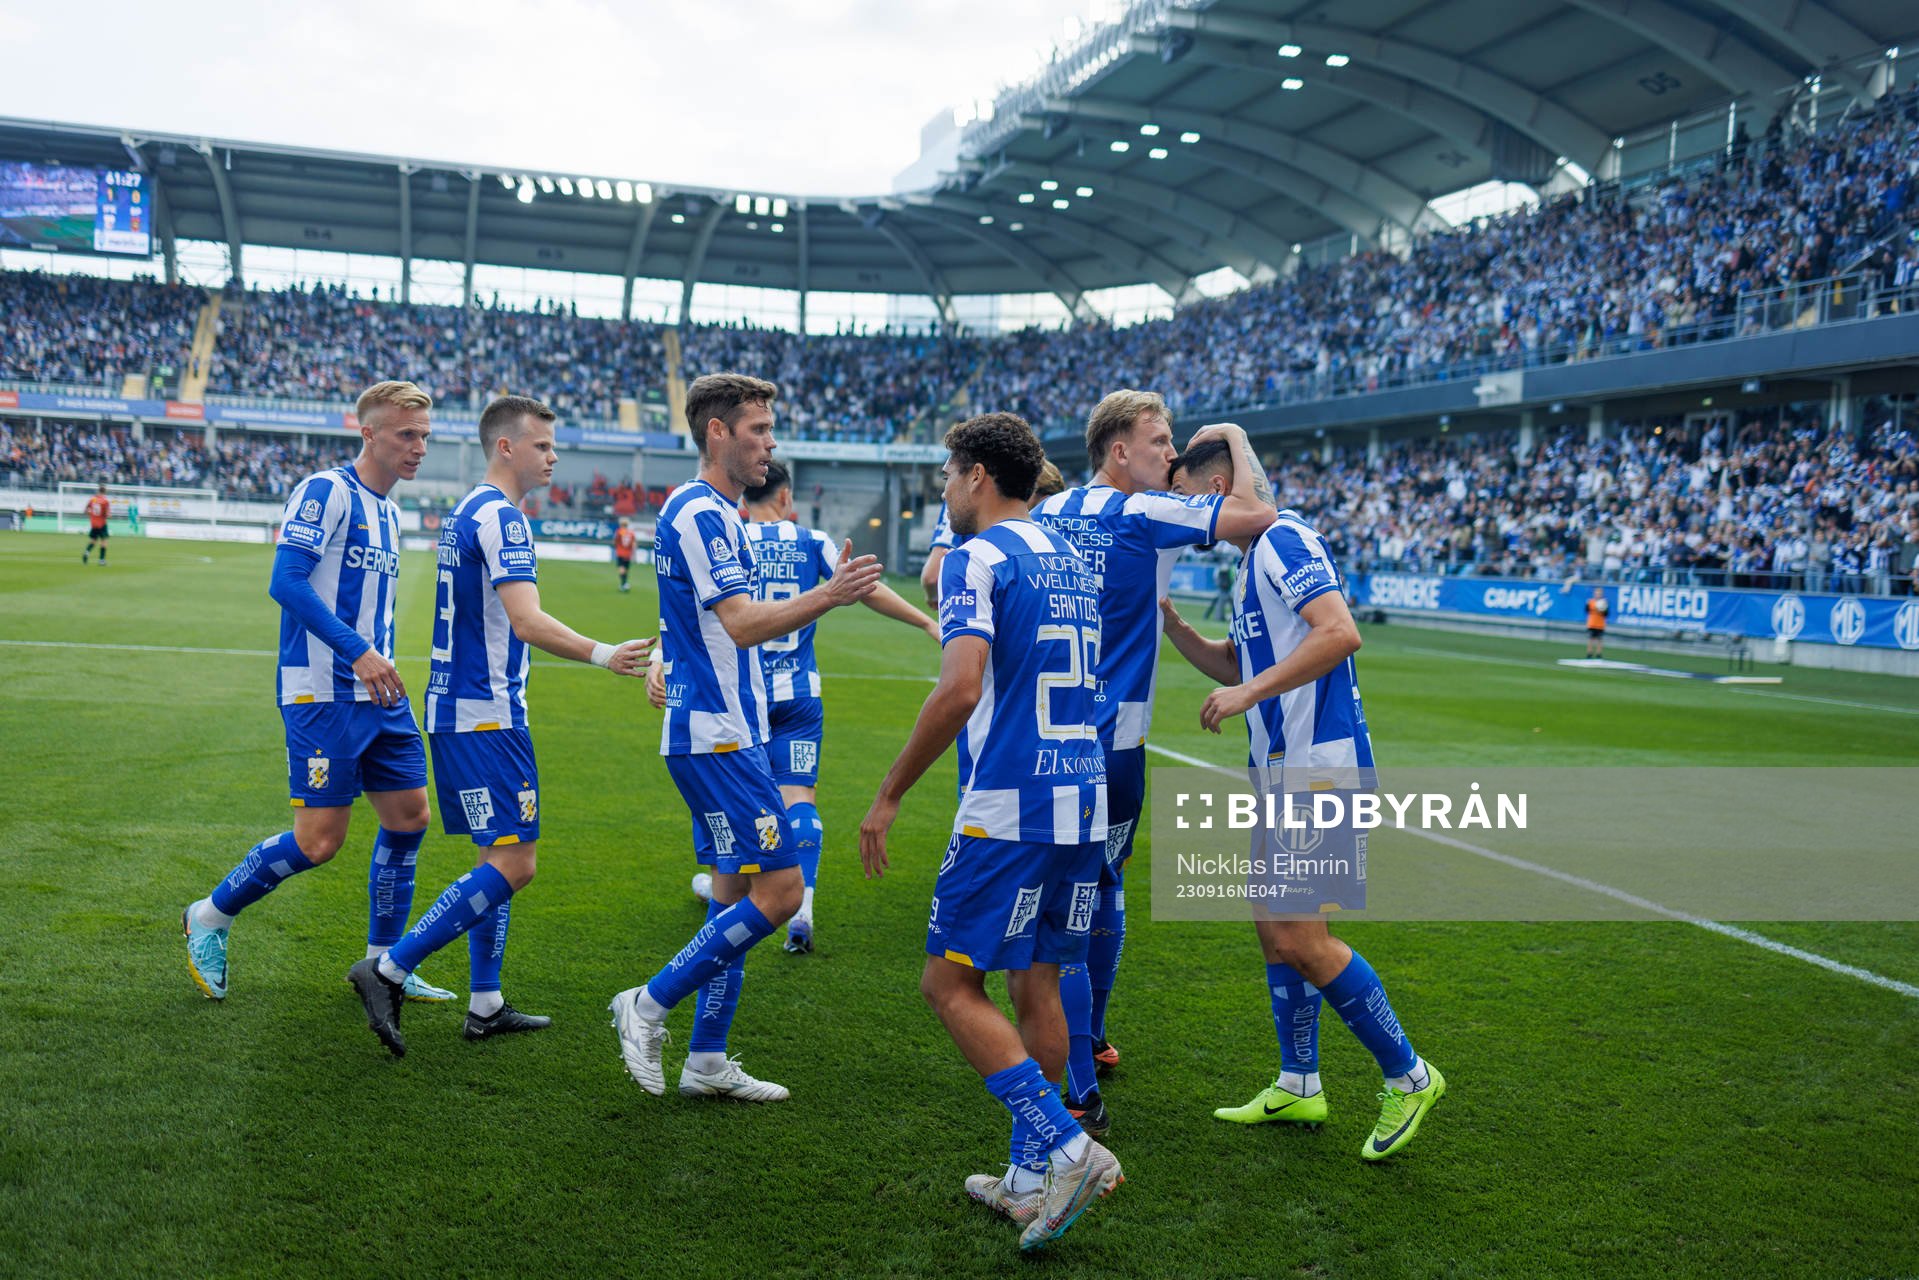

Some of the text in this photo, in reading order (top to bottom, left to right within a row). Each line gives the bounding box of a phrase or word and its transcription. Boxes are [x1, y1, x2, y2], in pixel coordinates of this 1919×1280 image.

[287, 523, 323, 538] UNIBET
[1041, 516, 1098, 531] NORDIC
[346, 546, 399, 578] SERNE
[501, 551, 534, 561] UNIBET
[756, 551, 808, 562] ELLNESS
[1038, 556, 1089, 576] NORDIC
[1285, 559, 1324, 587] morris
[1369, 575, 1440, 609] SERNEKE
[1484, 587, 1536, 611] CRAFT
[1617, 586, 1709, 619] FAMECO
[1049, 594, 1097, 622] SANTOS
[462, 791, 483, 804] EFF
[466, 803, 489, 815] EKT
[469, 815, 480, 827] IV
[408, 883, 462, 939] SILFVERLOK
[668, 919, 717, 973] SILFVERLOK
[1365, 985, 1406, 1046] SILFVERLOK
[1292, 1004, 1315, 1063] SILFVERLOK
